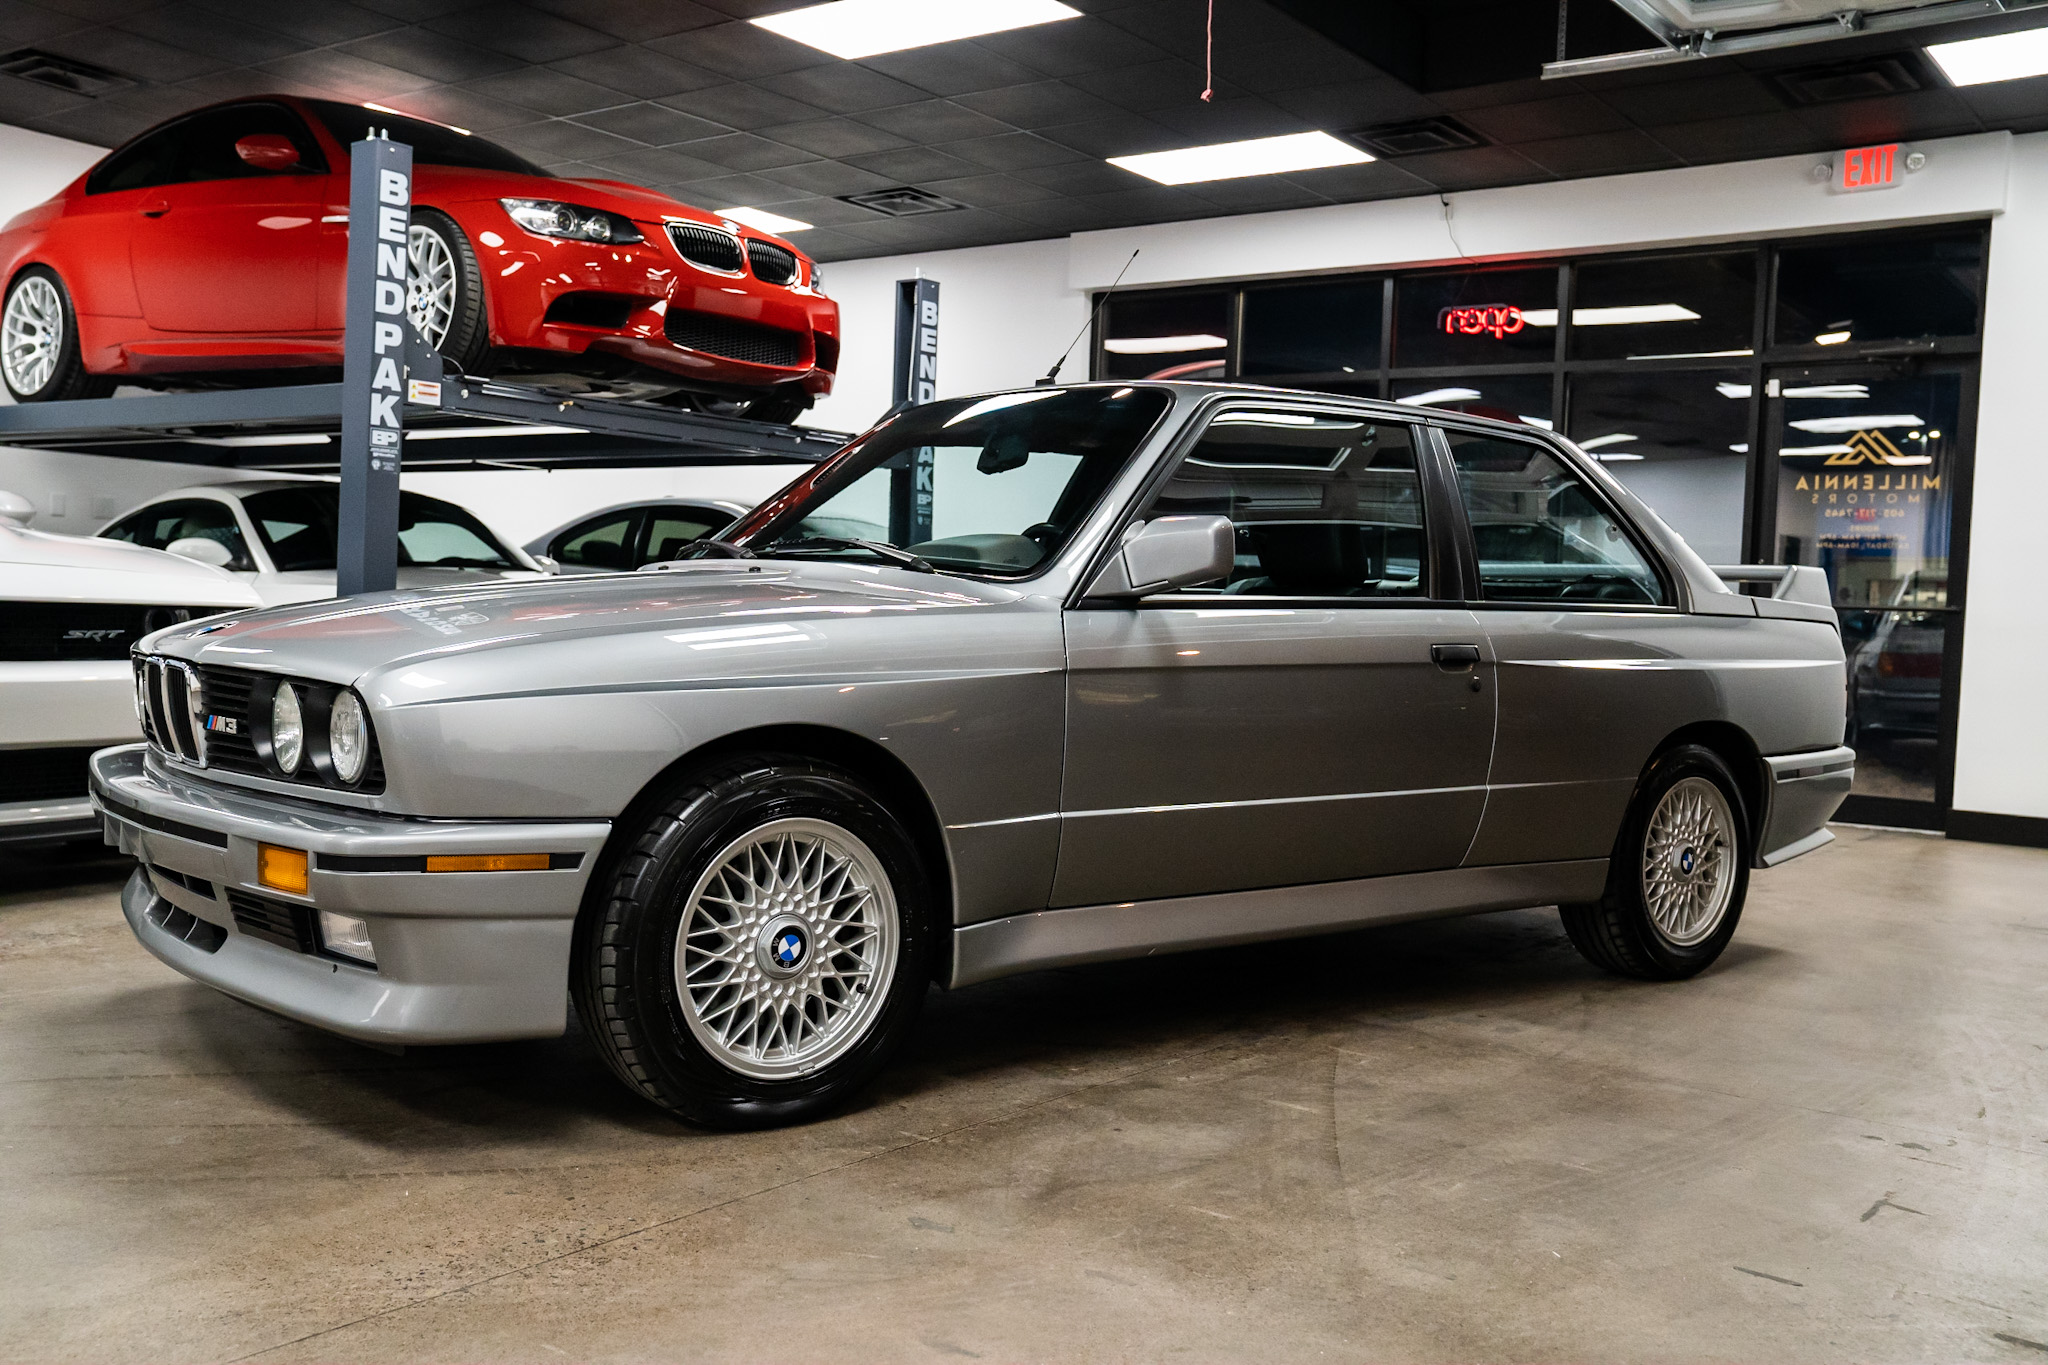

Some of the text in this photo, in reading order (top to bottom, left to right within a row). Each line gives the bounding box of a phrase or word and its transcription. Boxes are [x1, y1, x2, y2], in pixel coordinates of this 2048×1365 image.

[1843, 144, 1898, 188] EXIT
[370, 169, 409, 428] BENDPAK
[62, 629, 126, 643] SRT
[215, 715, 238, 734] M3
